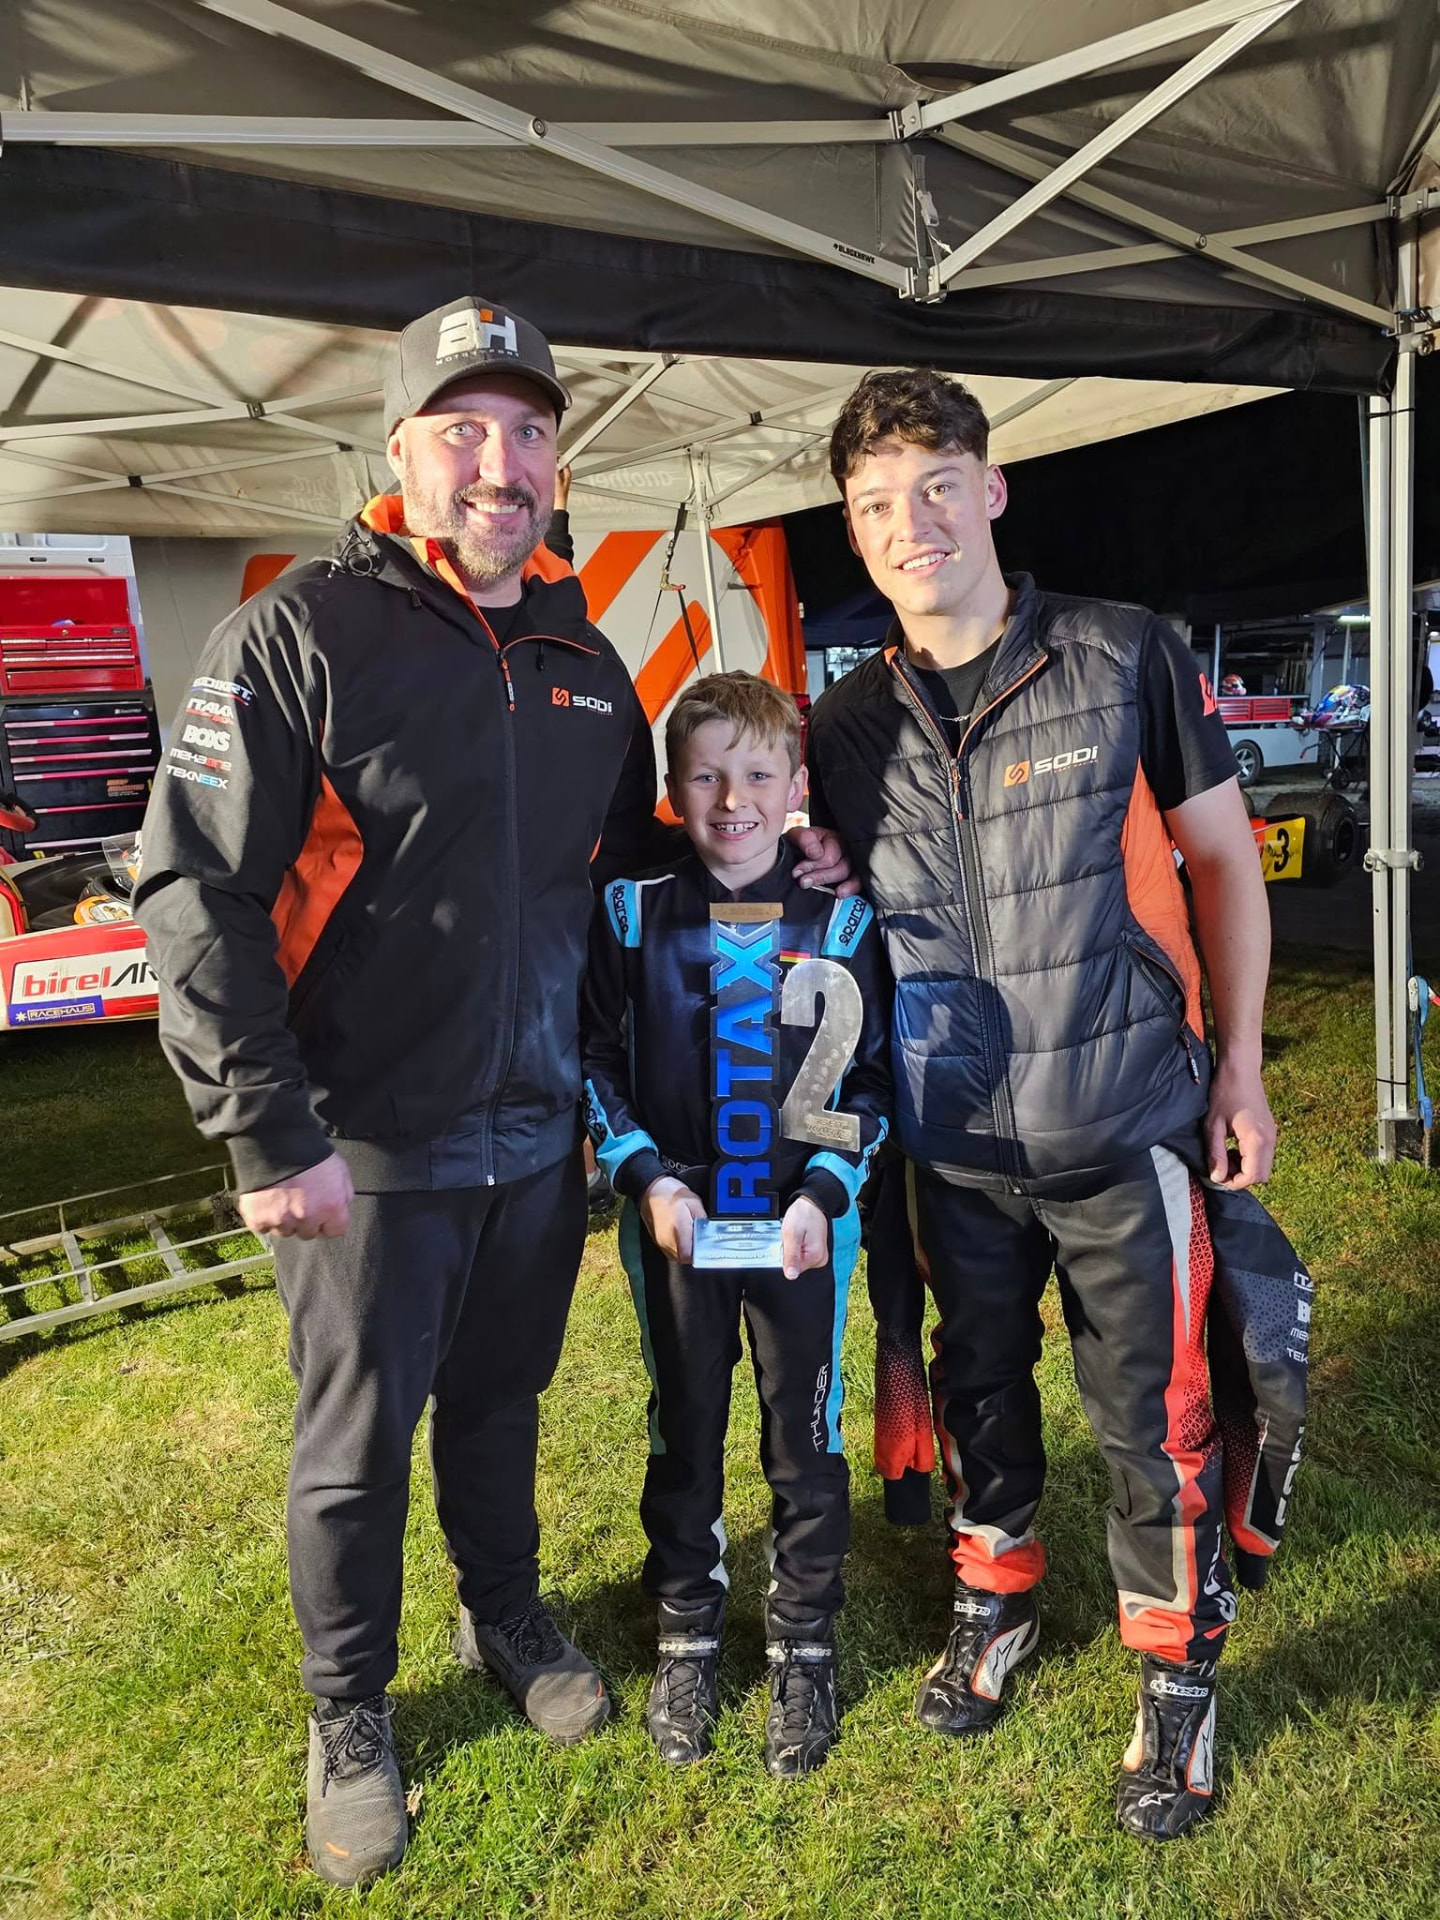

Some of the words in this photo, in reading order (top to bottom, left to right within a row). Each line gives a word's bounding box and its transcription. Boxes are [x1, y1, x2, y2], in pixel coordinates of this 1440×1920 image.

[1273, 827, 1290, 873] 3
[838, 899, 867, 947] sparco
[717, 932, 773, 1213] ROTAX
[780, 958, 864, 1153] 2
[810, 1363, 829, 1452] THUNDER
